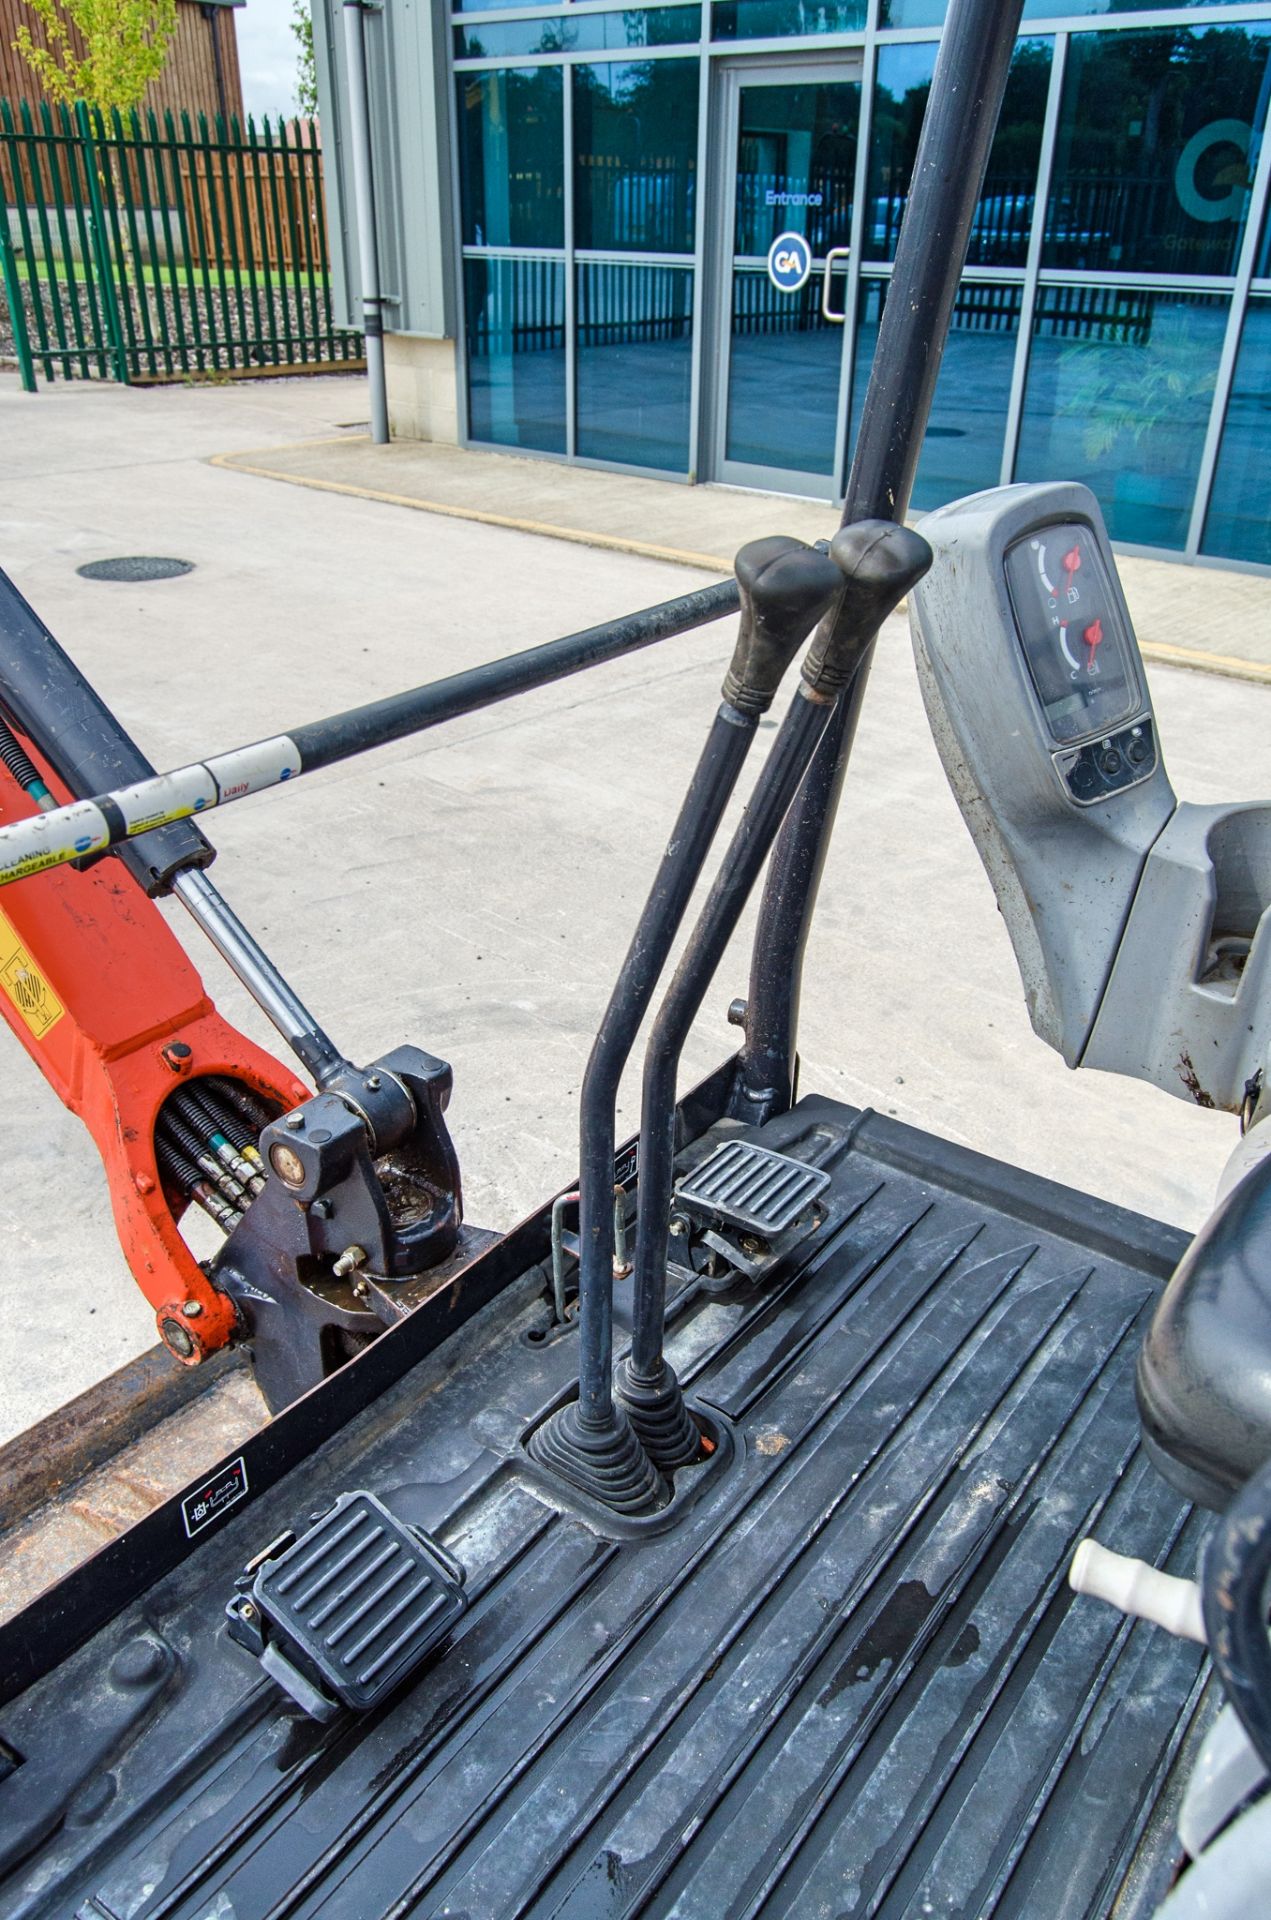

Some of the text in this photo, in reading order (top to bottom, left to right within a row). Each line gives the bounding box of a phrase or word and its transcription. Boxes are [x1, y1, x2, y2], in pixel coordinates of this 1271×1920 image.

[765, 190, 823, 206] Entrance
[774, 251, 803, 274] GA
[0, 851, 66, 882] HARGEABLE
